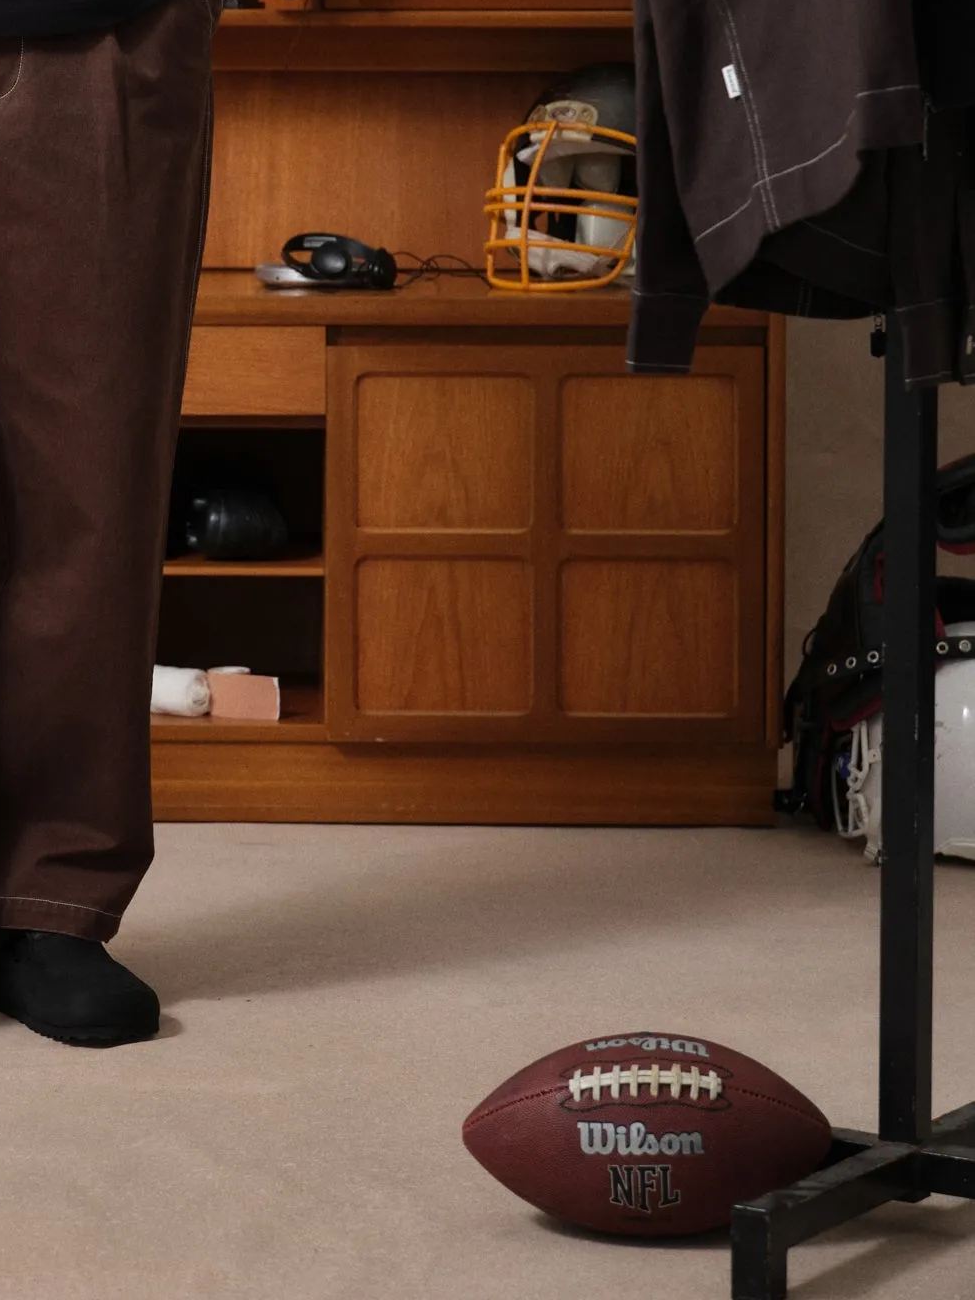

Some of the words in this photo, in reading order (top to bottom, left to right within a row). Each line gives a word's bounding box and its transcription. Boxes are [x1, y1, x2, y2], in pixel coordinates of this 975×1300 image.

[586, 1037, 709, 1057] Wilson
[577, 1121, 705, 1156] Wilson
[608, 1164, 681, 1213] NFL
